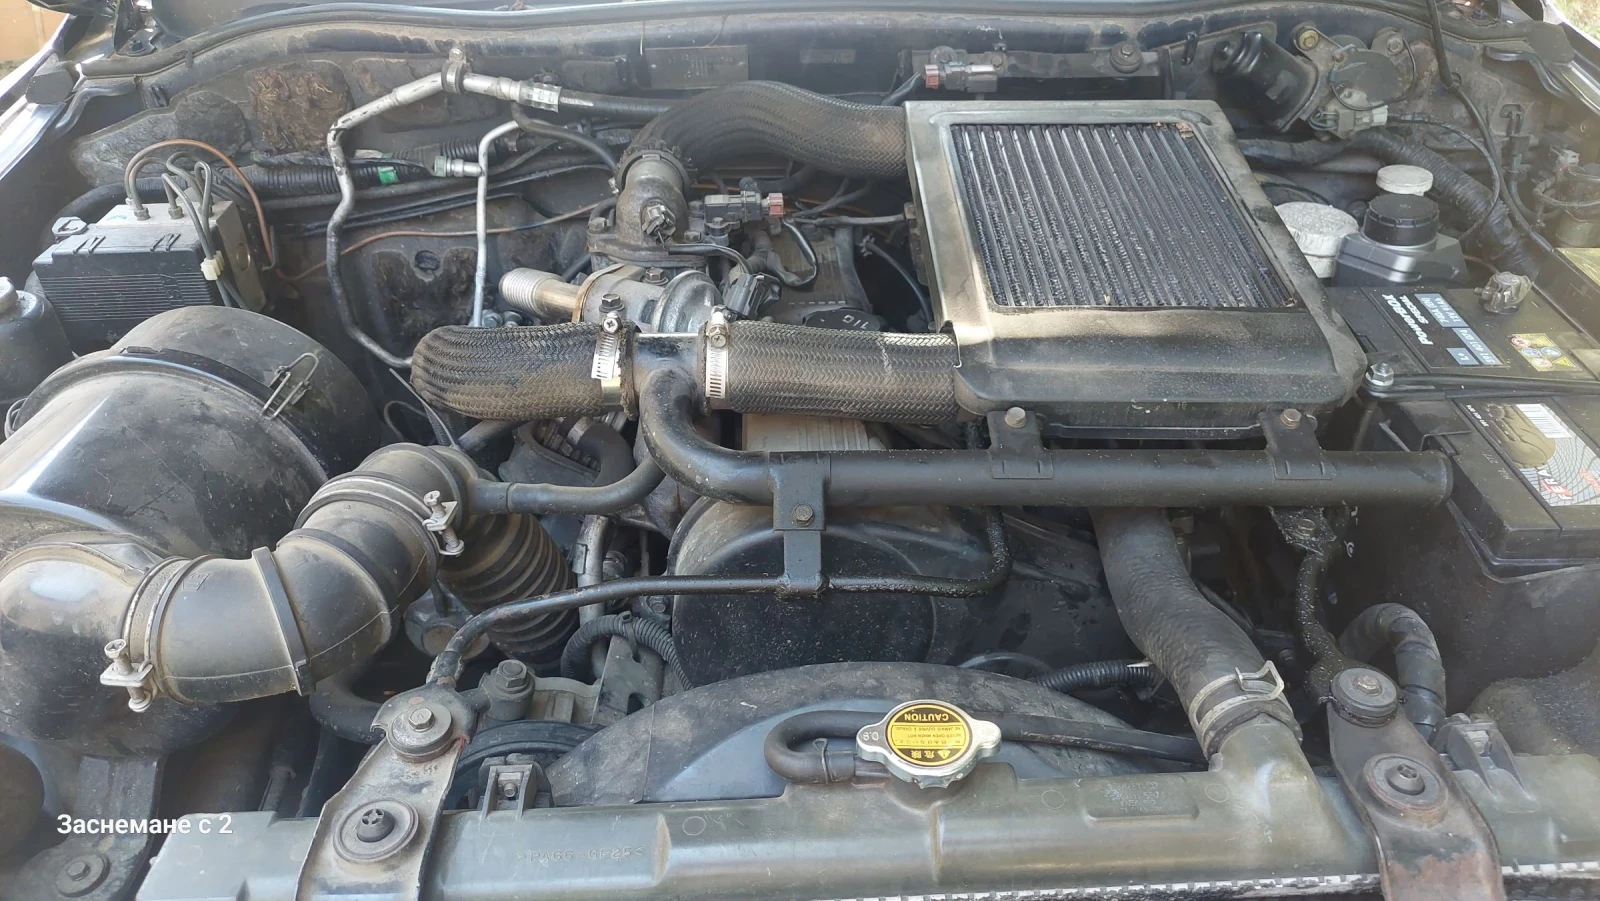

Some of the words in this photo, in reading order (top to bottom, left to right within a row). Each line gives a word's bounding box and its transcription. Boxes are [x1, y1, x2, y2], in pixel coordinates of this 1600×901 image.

[1400, 295, 1429, 324] SPECIAL
[842, 314, 869, 329] OIL
[904, 713, 949, 722] CAUTION
